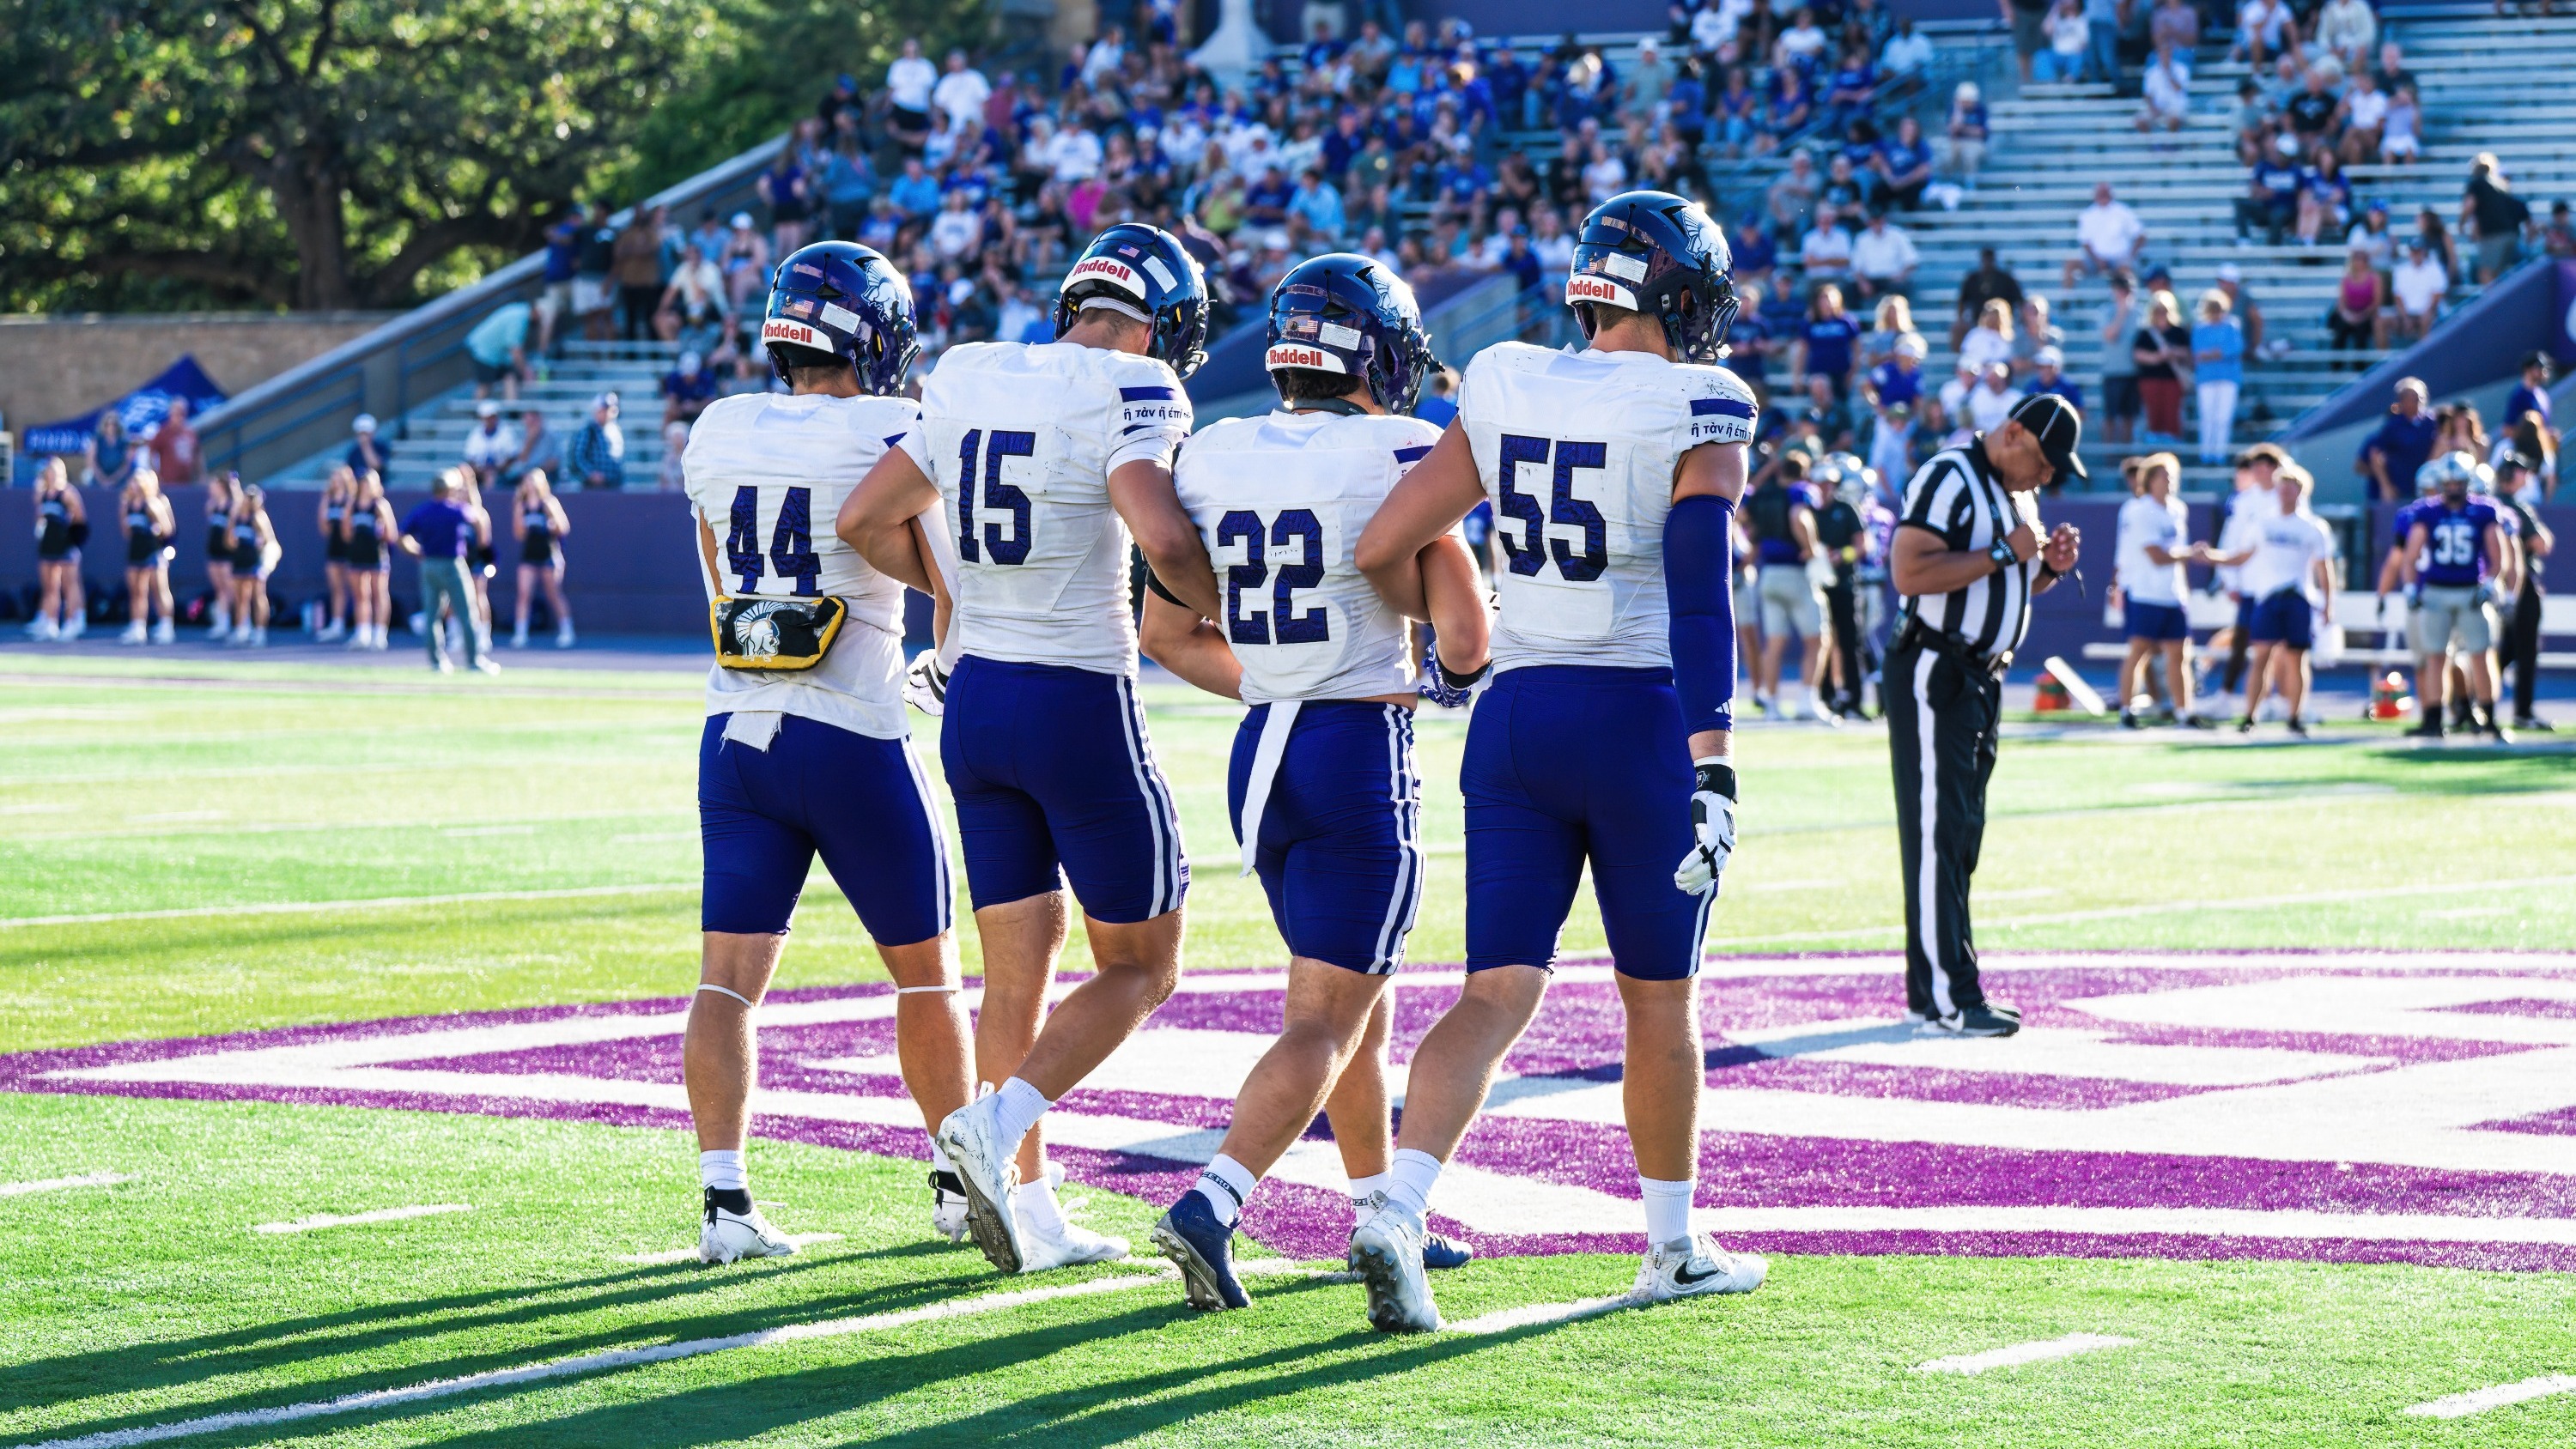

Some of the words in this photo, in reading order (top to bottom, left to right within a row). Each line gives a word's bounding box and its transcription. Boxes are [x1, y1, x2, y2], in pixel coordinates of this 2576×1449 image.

[1072, 260, 1131, 282] Riddell
[1567, 280, 1615, 300] Riddell
[764, 323, 812, 343] Riddell
[1269, 349, 1322, 367] Riddell
[958, 428, 1036, 566] 15
[1498, 433, 1609, 582] 55
[726, 485, 824, 597] 44
[2433, 524, 2474, 566] 35
[1216, 508, 1330, 646] 22
